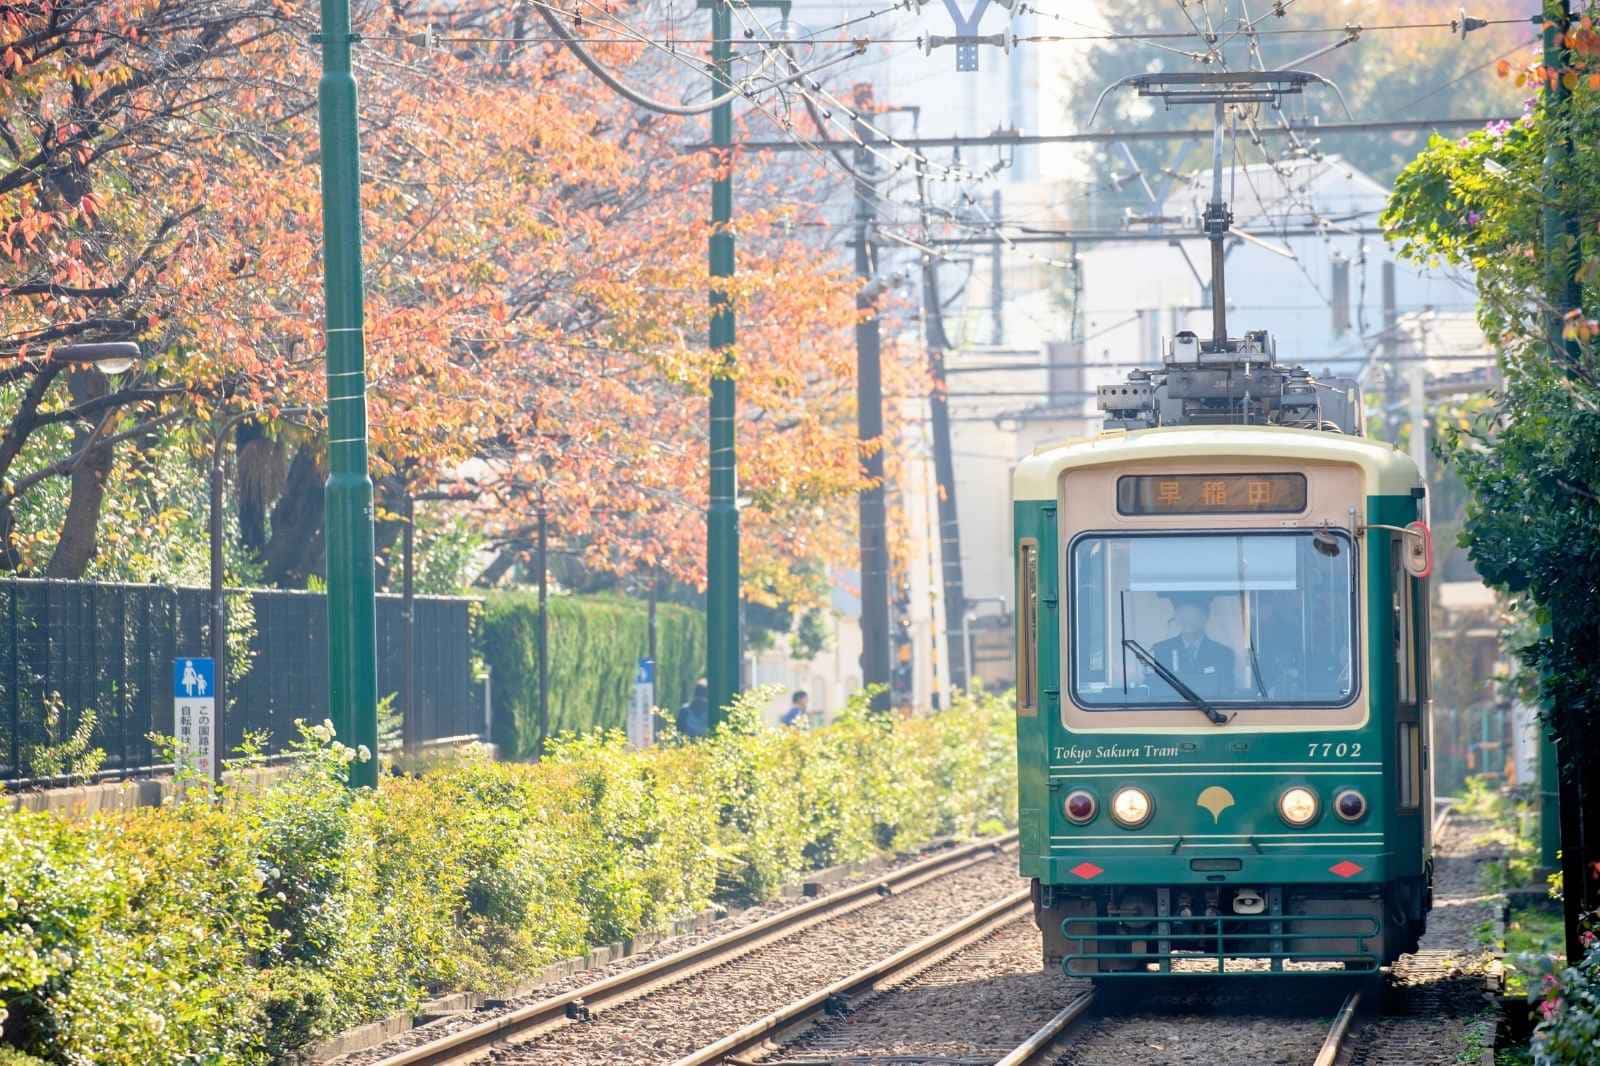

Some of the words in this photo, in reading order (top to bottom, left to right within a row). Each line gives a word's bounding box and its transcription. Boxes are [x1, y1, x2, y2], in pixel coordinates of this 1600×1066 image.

[1158, 480, 1272, 505] 早稲田
[1054, 744, 1092, 764] Tokyo
[1096, 743, 1140, 758] Sakura
[1144, 744, 1179, 757] Tram
[1308, 743, 1361, 757] 7702
